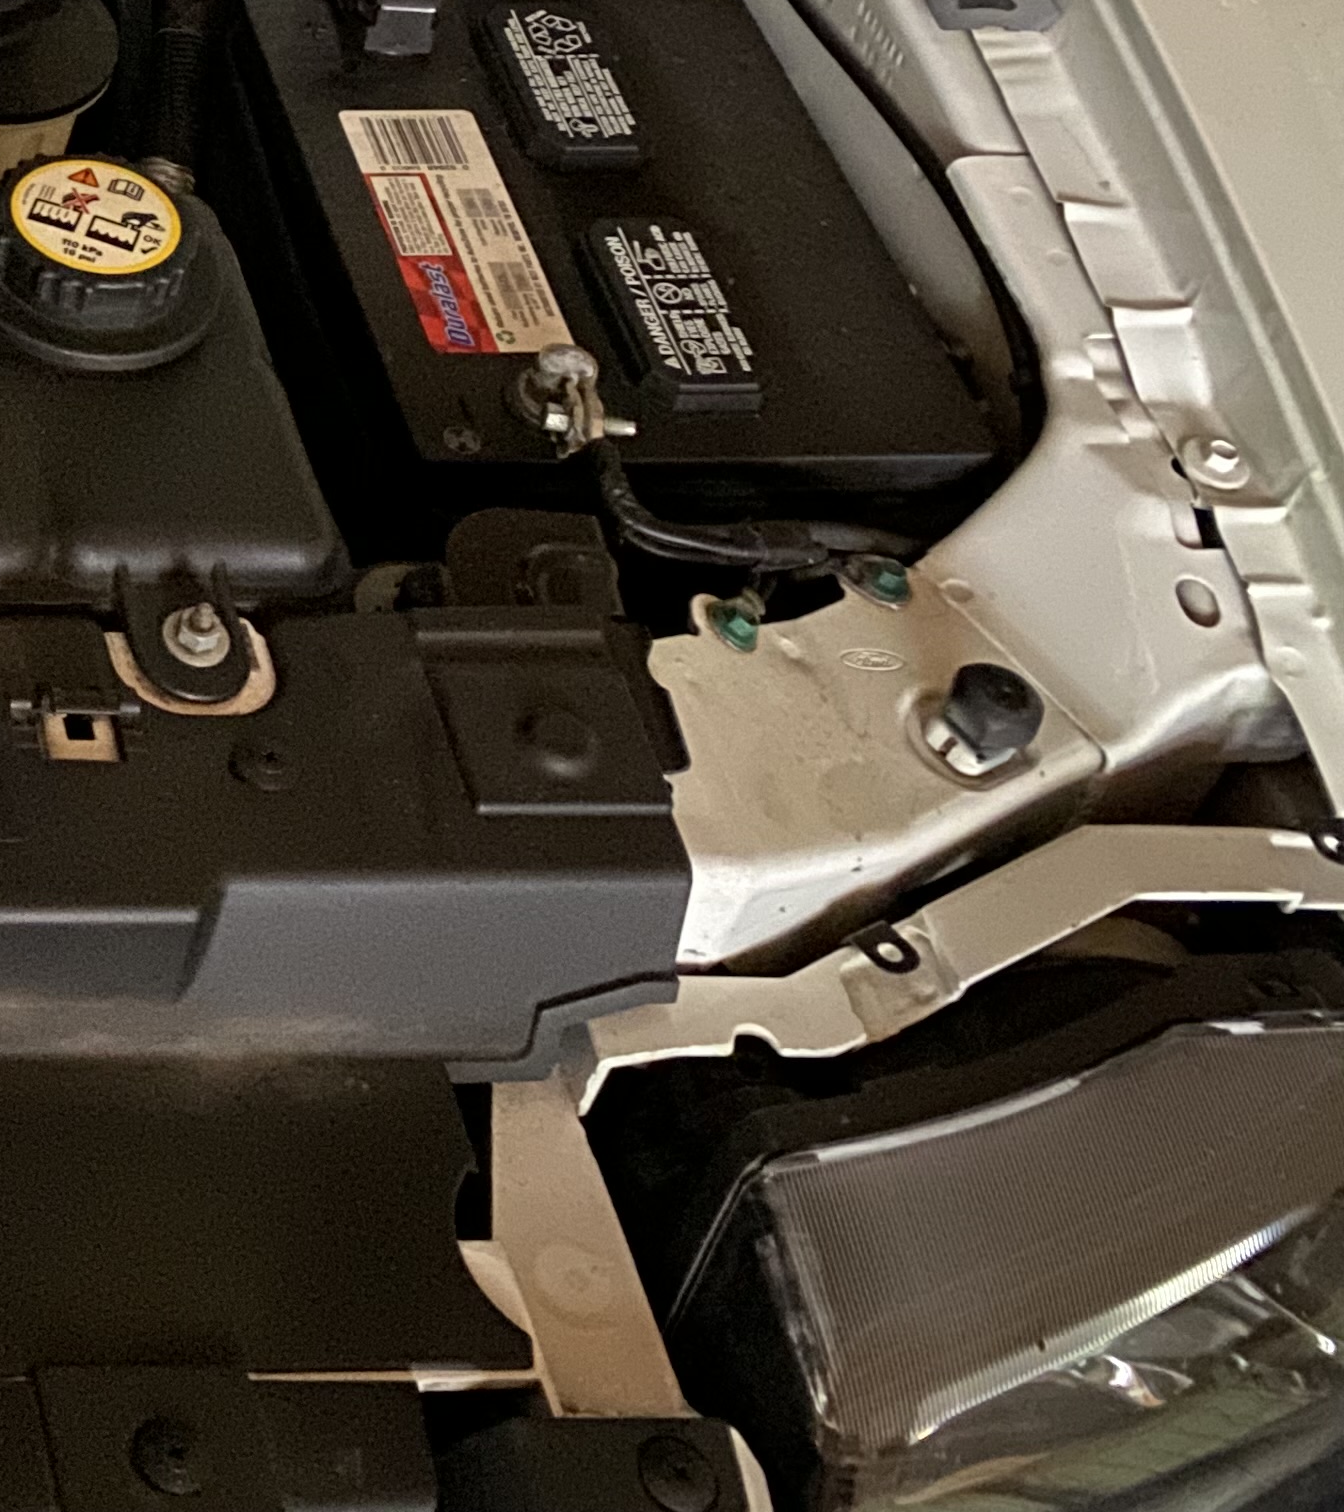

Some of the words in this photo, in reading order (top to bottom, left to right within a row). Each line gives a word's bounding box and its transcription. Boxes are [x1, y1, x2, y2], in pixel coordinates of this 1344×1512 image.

[82, 243, 103, 257] kPa
[143, 233, 162, 246] OK
[78, 252, 96, 264] psi
[604, 236, 642, 285] POISON
[418, 261, 476, 349] Duralast
[634, 298, 676, 355] DANGER
